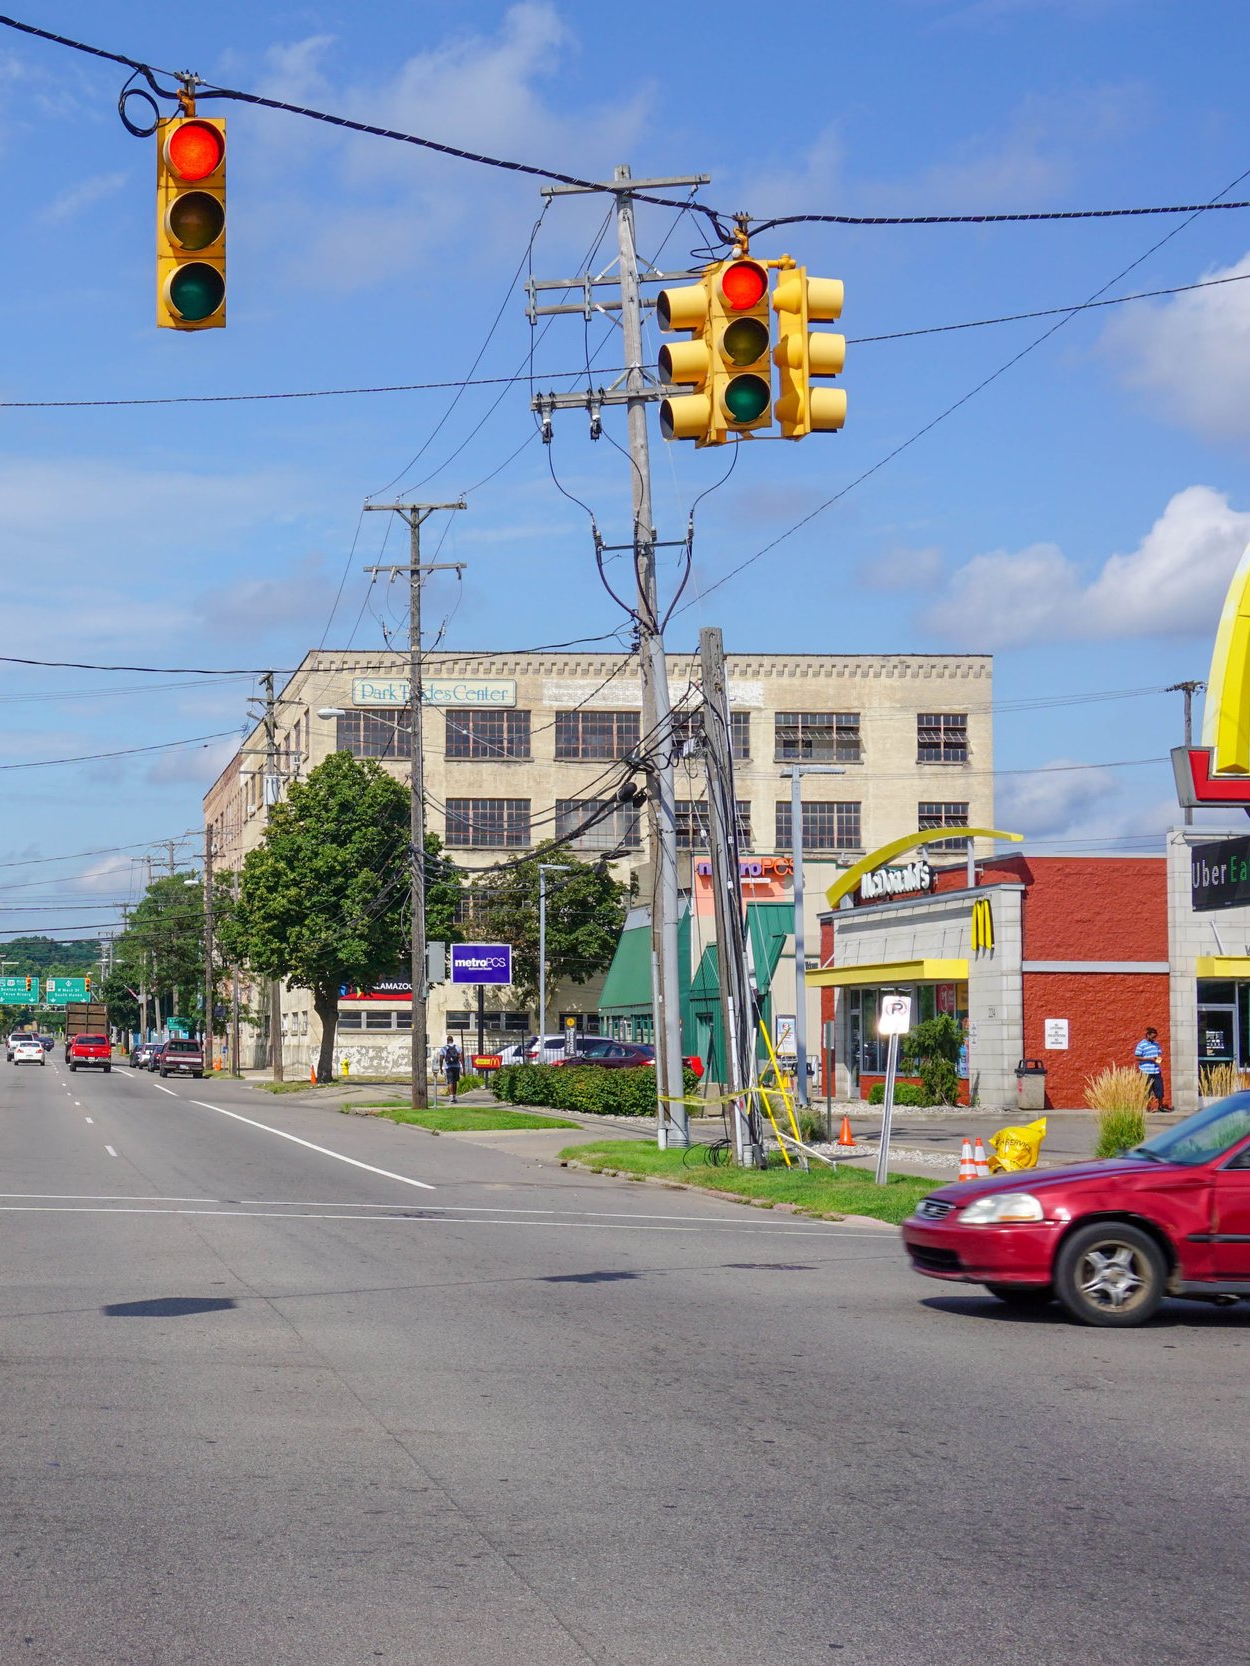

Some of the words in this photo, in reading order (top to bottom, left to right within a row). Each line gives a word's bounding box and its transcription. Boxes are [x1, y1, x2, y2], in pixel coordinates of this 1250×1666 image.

[361, 684, 399, 700] Park
[400, 683, 451, 700] Tdes
[453, 684, 508, 700] Center
[1192, 859, 1227, 889] Uber
[1230, 855, 1250, 883] Ea
